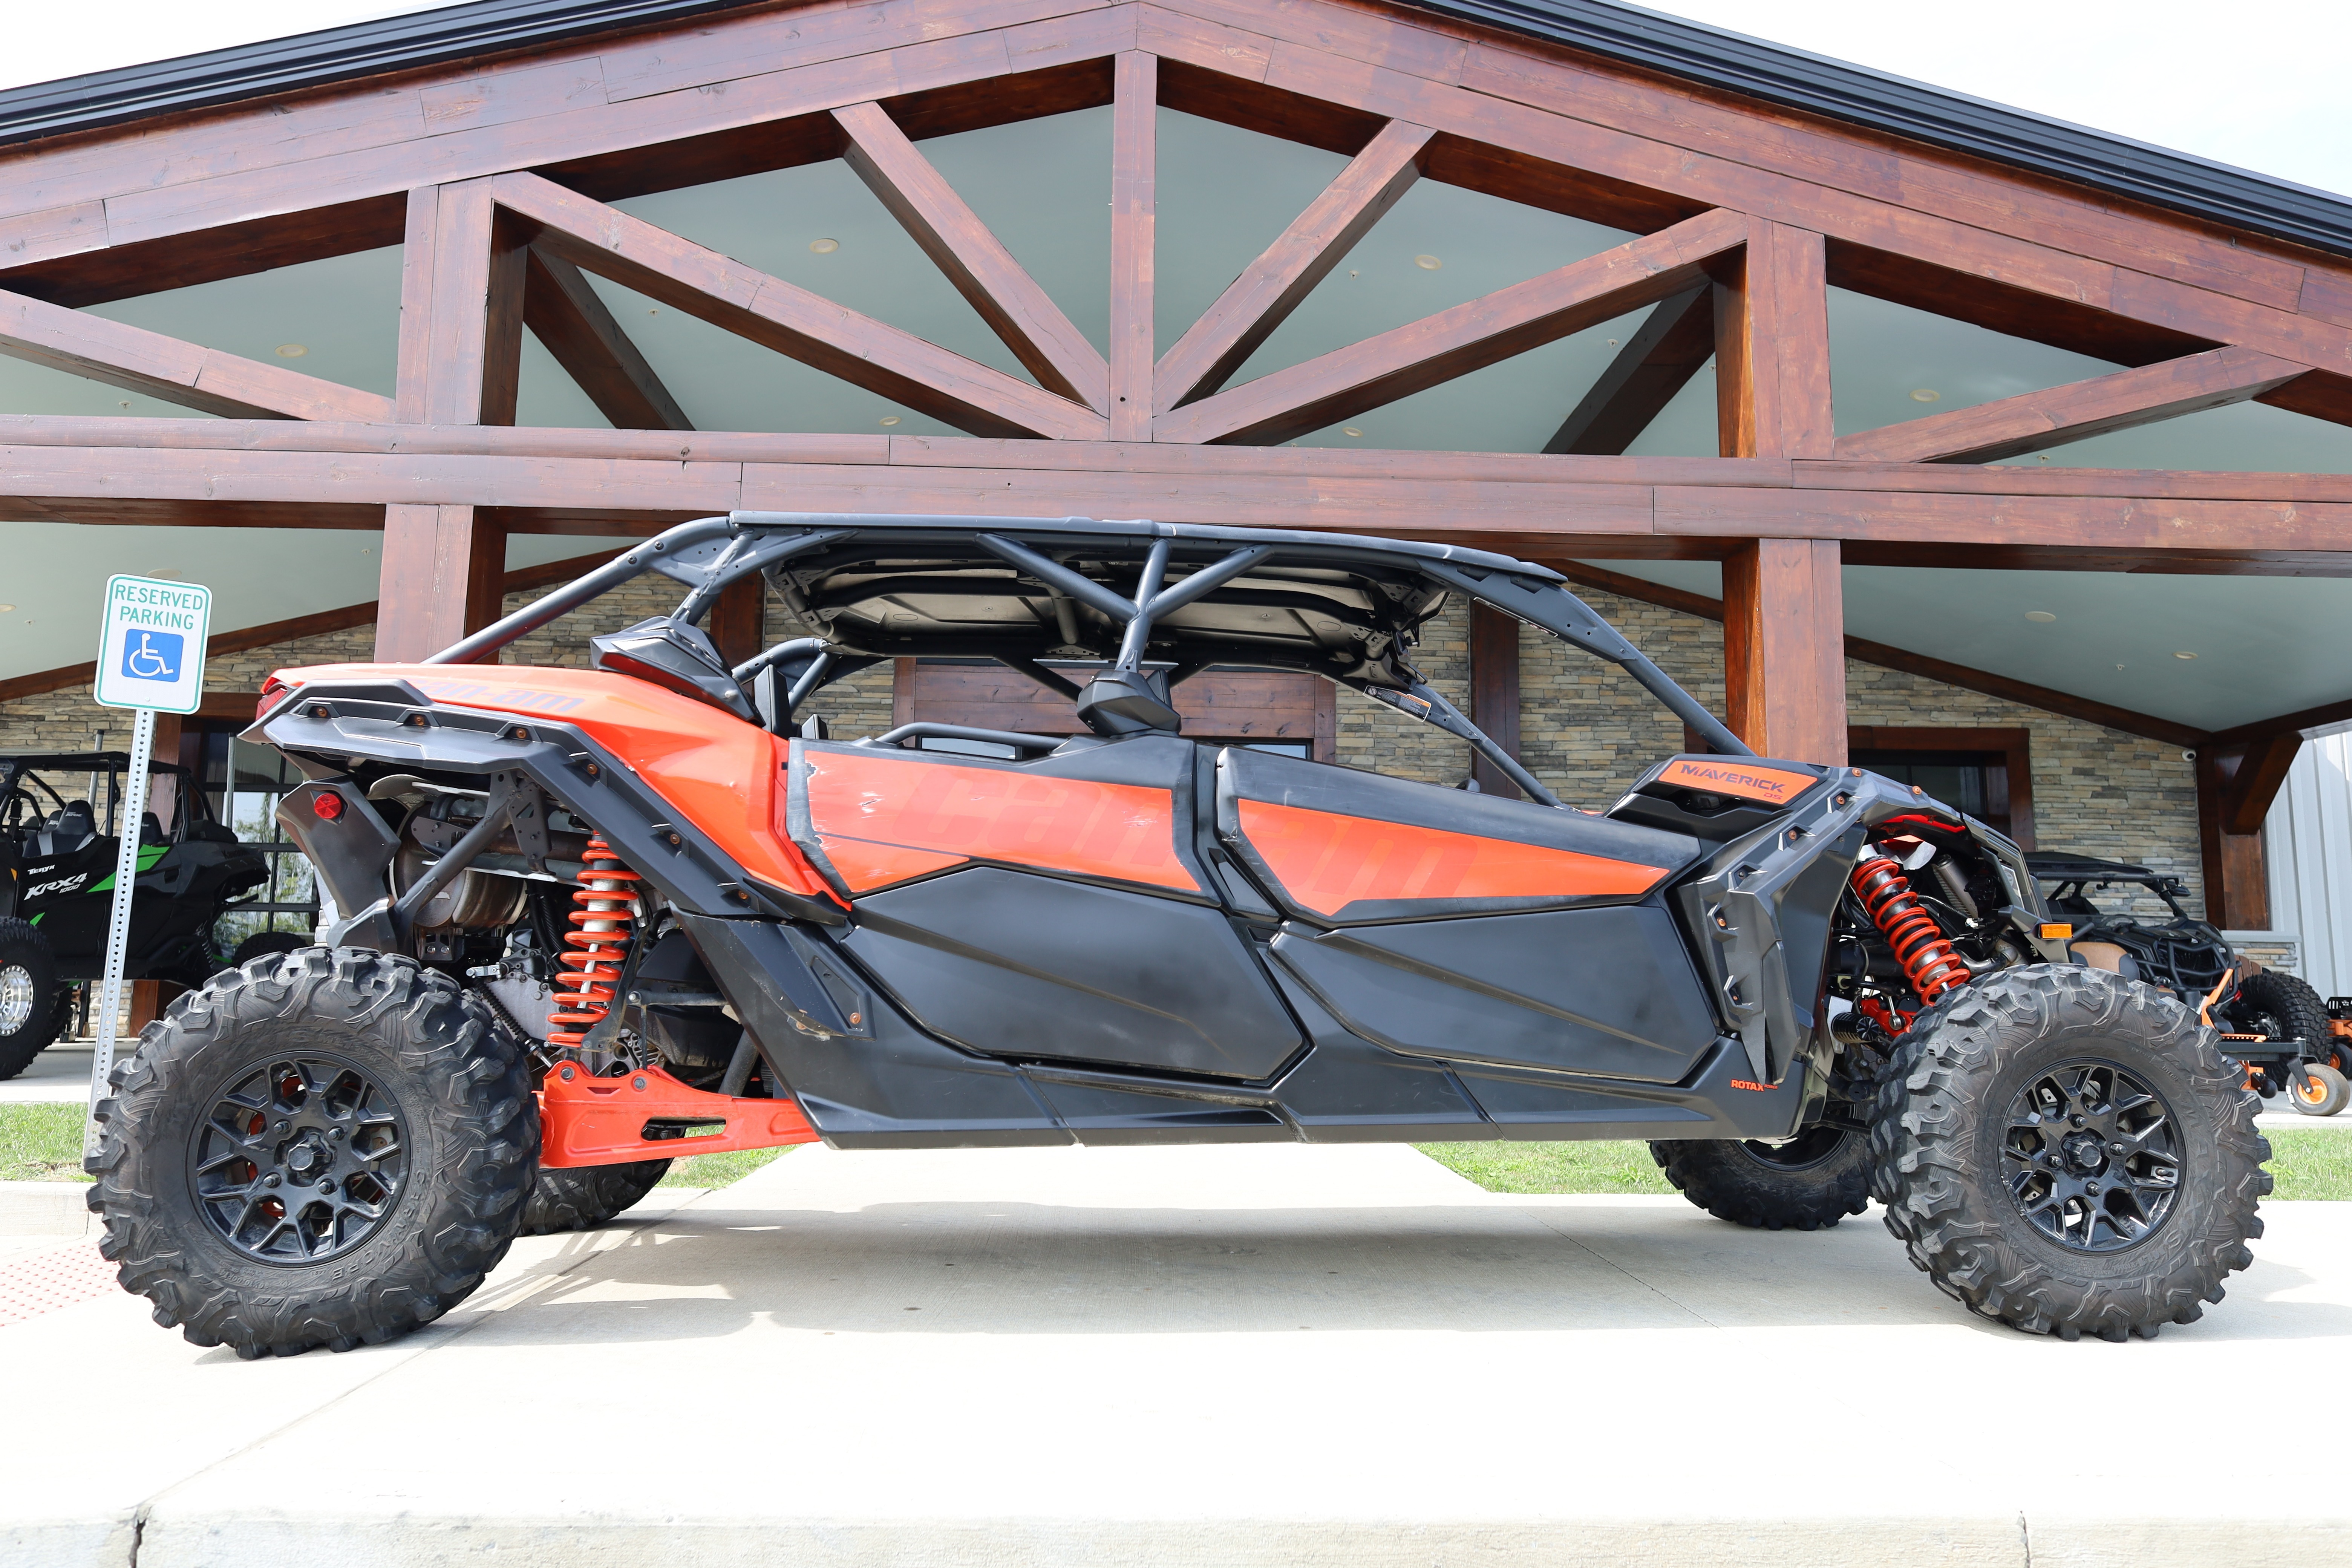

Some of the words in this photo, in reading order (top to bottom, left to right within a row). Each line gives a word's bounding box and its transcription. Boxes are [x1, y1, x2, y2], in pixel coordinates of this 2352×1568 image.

[115, 585, 203, 610] RESERVED
[120, 606, 194, 629] PARKING
[1680, 764, 1786, 793] MAVERICK
[59, 884, 81, 894] 1000
[1731, 1079, 1764, 1092] ROTAX
